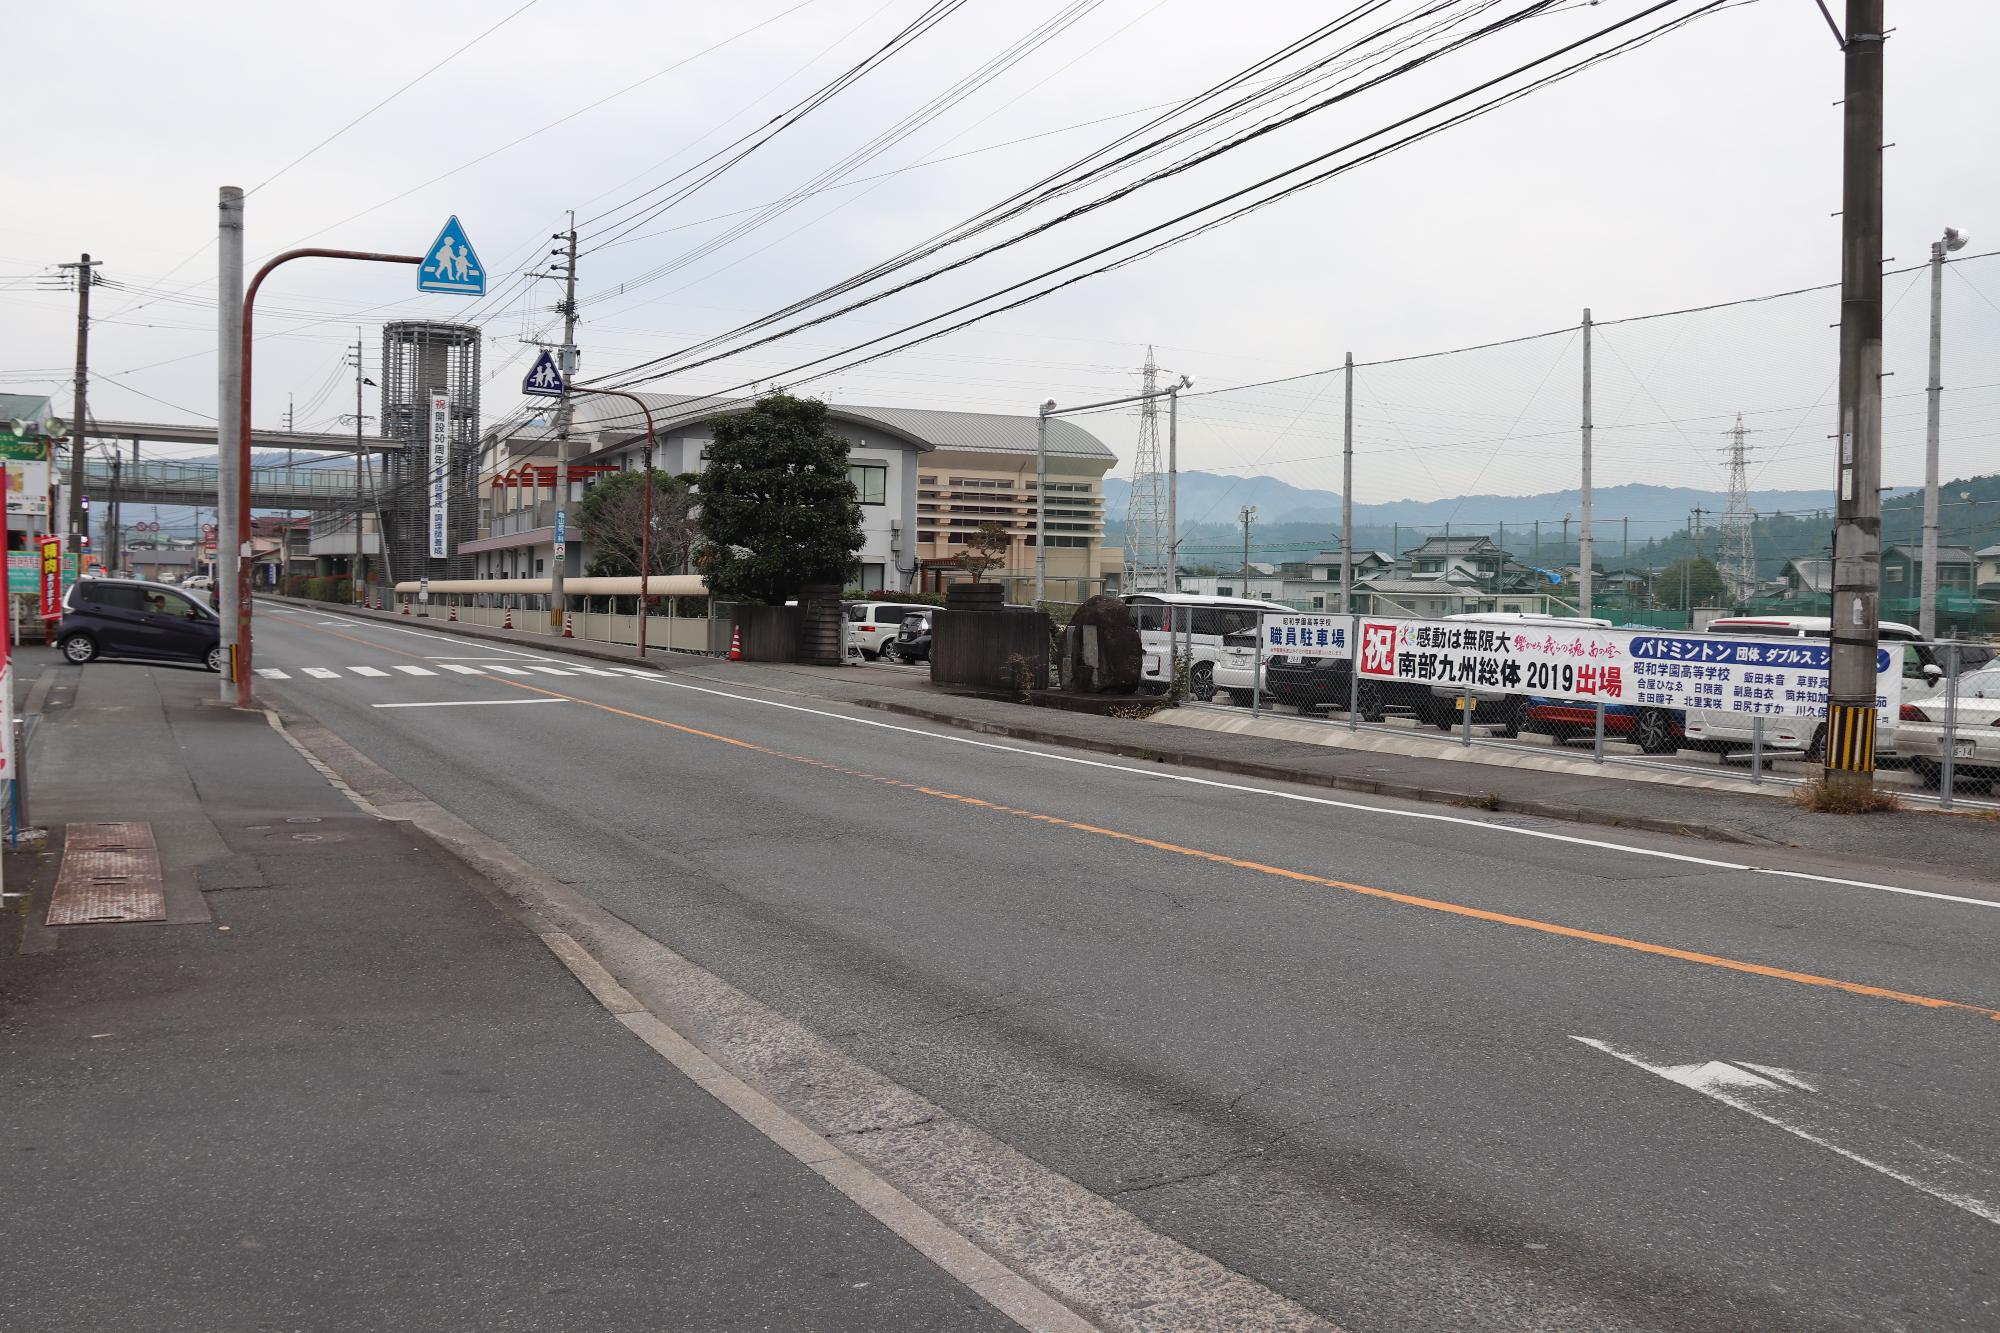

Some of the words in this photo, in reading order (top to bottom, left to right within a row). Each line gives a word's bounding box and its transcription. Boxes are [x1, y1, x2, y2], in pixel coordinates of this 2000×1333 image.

[1282, 617, 1332, 627] 昭和学園高等学校
[1269, 626, 1345, 649] 職員駐車場
[1365, 626, 1393, 671] 祝
[1416, 626, 1512, 653] 感動は無限大
[1638, 639, 1732, 661] バドミントン
[1633, 661, 1730, 682] 昭和学園高等学校
[1743, 671, 1785, 686] 飯田朱音
[1733, 685, 1774, 700] 副島由衣
[1684, 696, 1722, 710] 北里実咲
[1733, 700, 1784, 714] 田尻すずか
